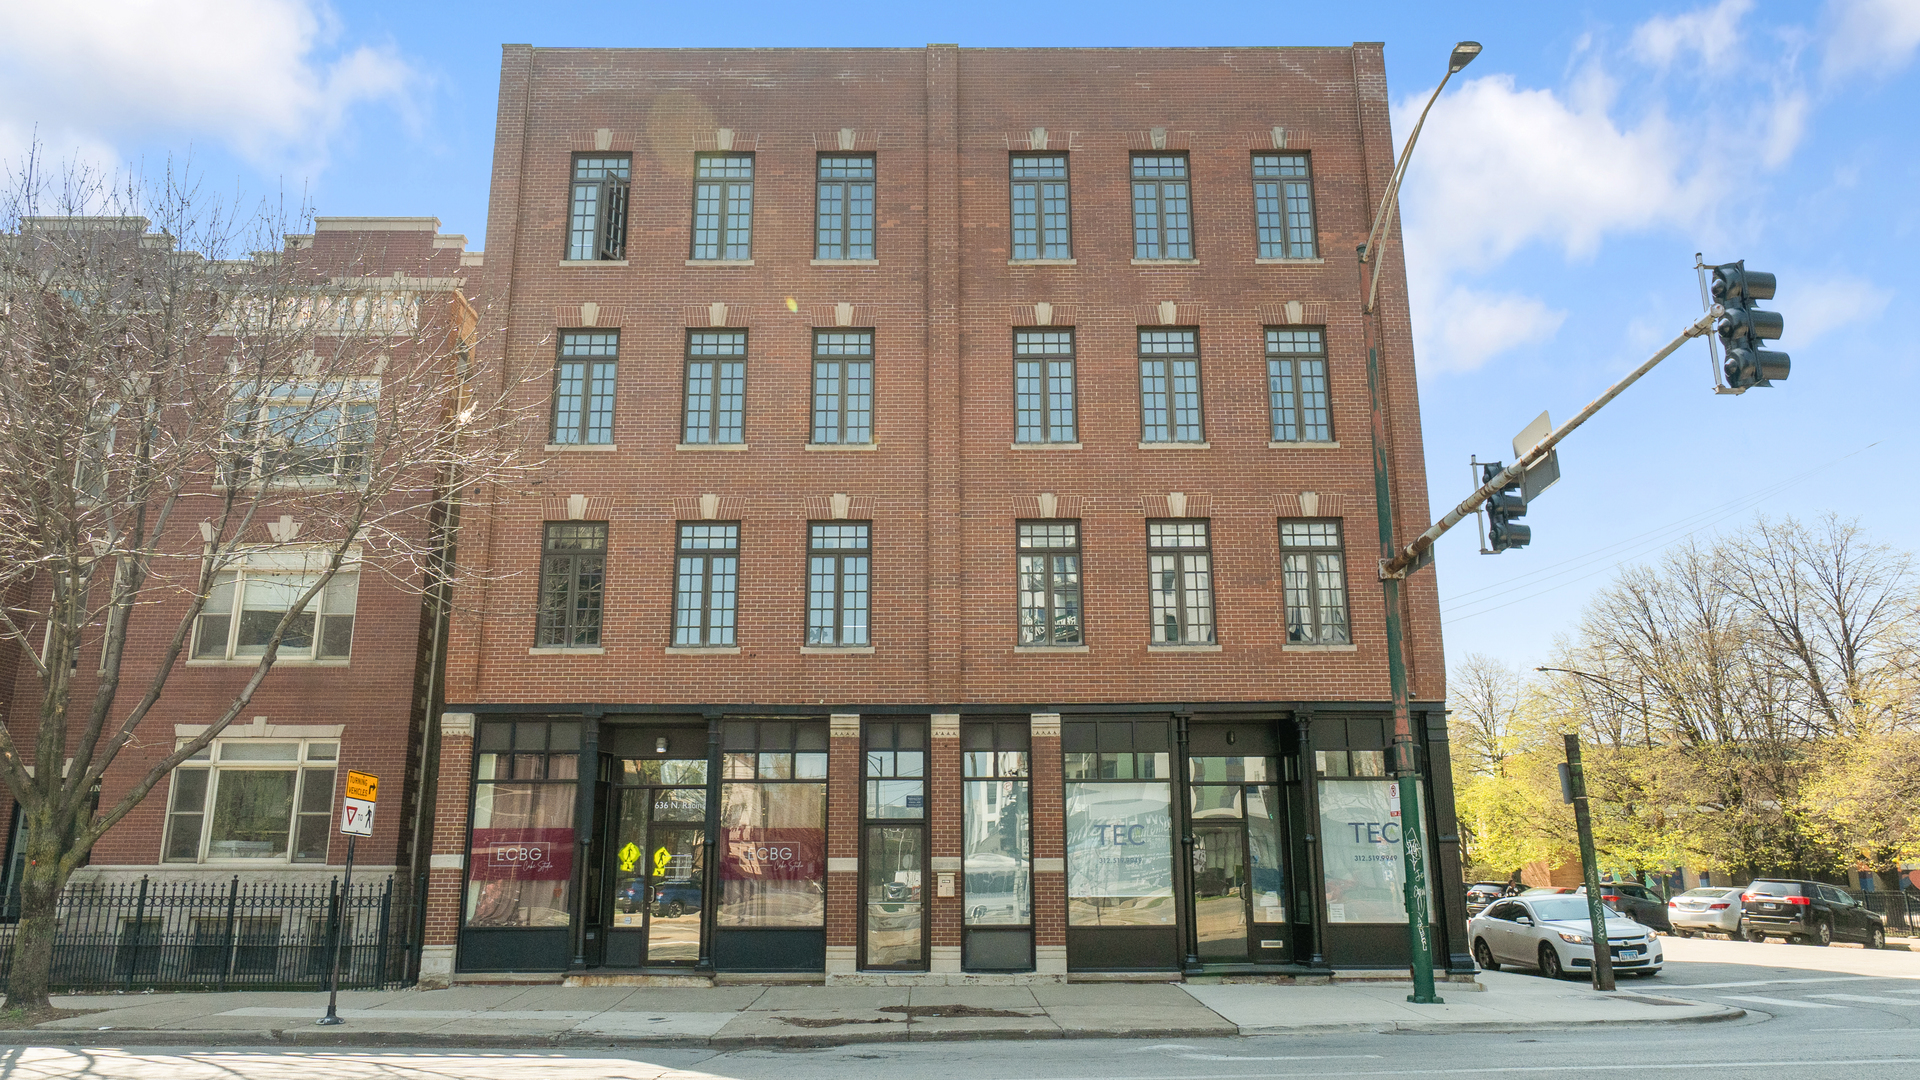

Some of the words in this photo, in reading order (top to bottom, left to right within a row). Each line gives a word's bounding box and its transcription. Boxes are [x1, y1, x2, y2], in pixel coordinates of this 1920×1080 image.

[350, 775, 368, 787] TURNING
[348, 786, 368, 797] VEHICLES
[654, 801, 669, 809] 636
[358, 813, 364, 821] TO
[1094, 824, 1145, 846] TEC
[1348, 822, 1400, 843] TEC
[497, 847, 542, 861] ECBG
[747, 847, 793, 861] ECBG
[1354, 854, 1398, 862] 312.519.9949
[522, 860, 536, 871] Cake
